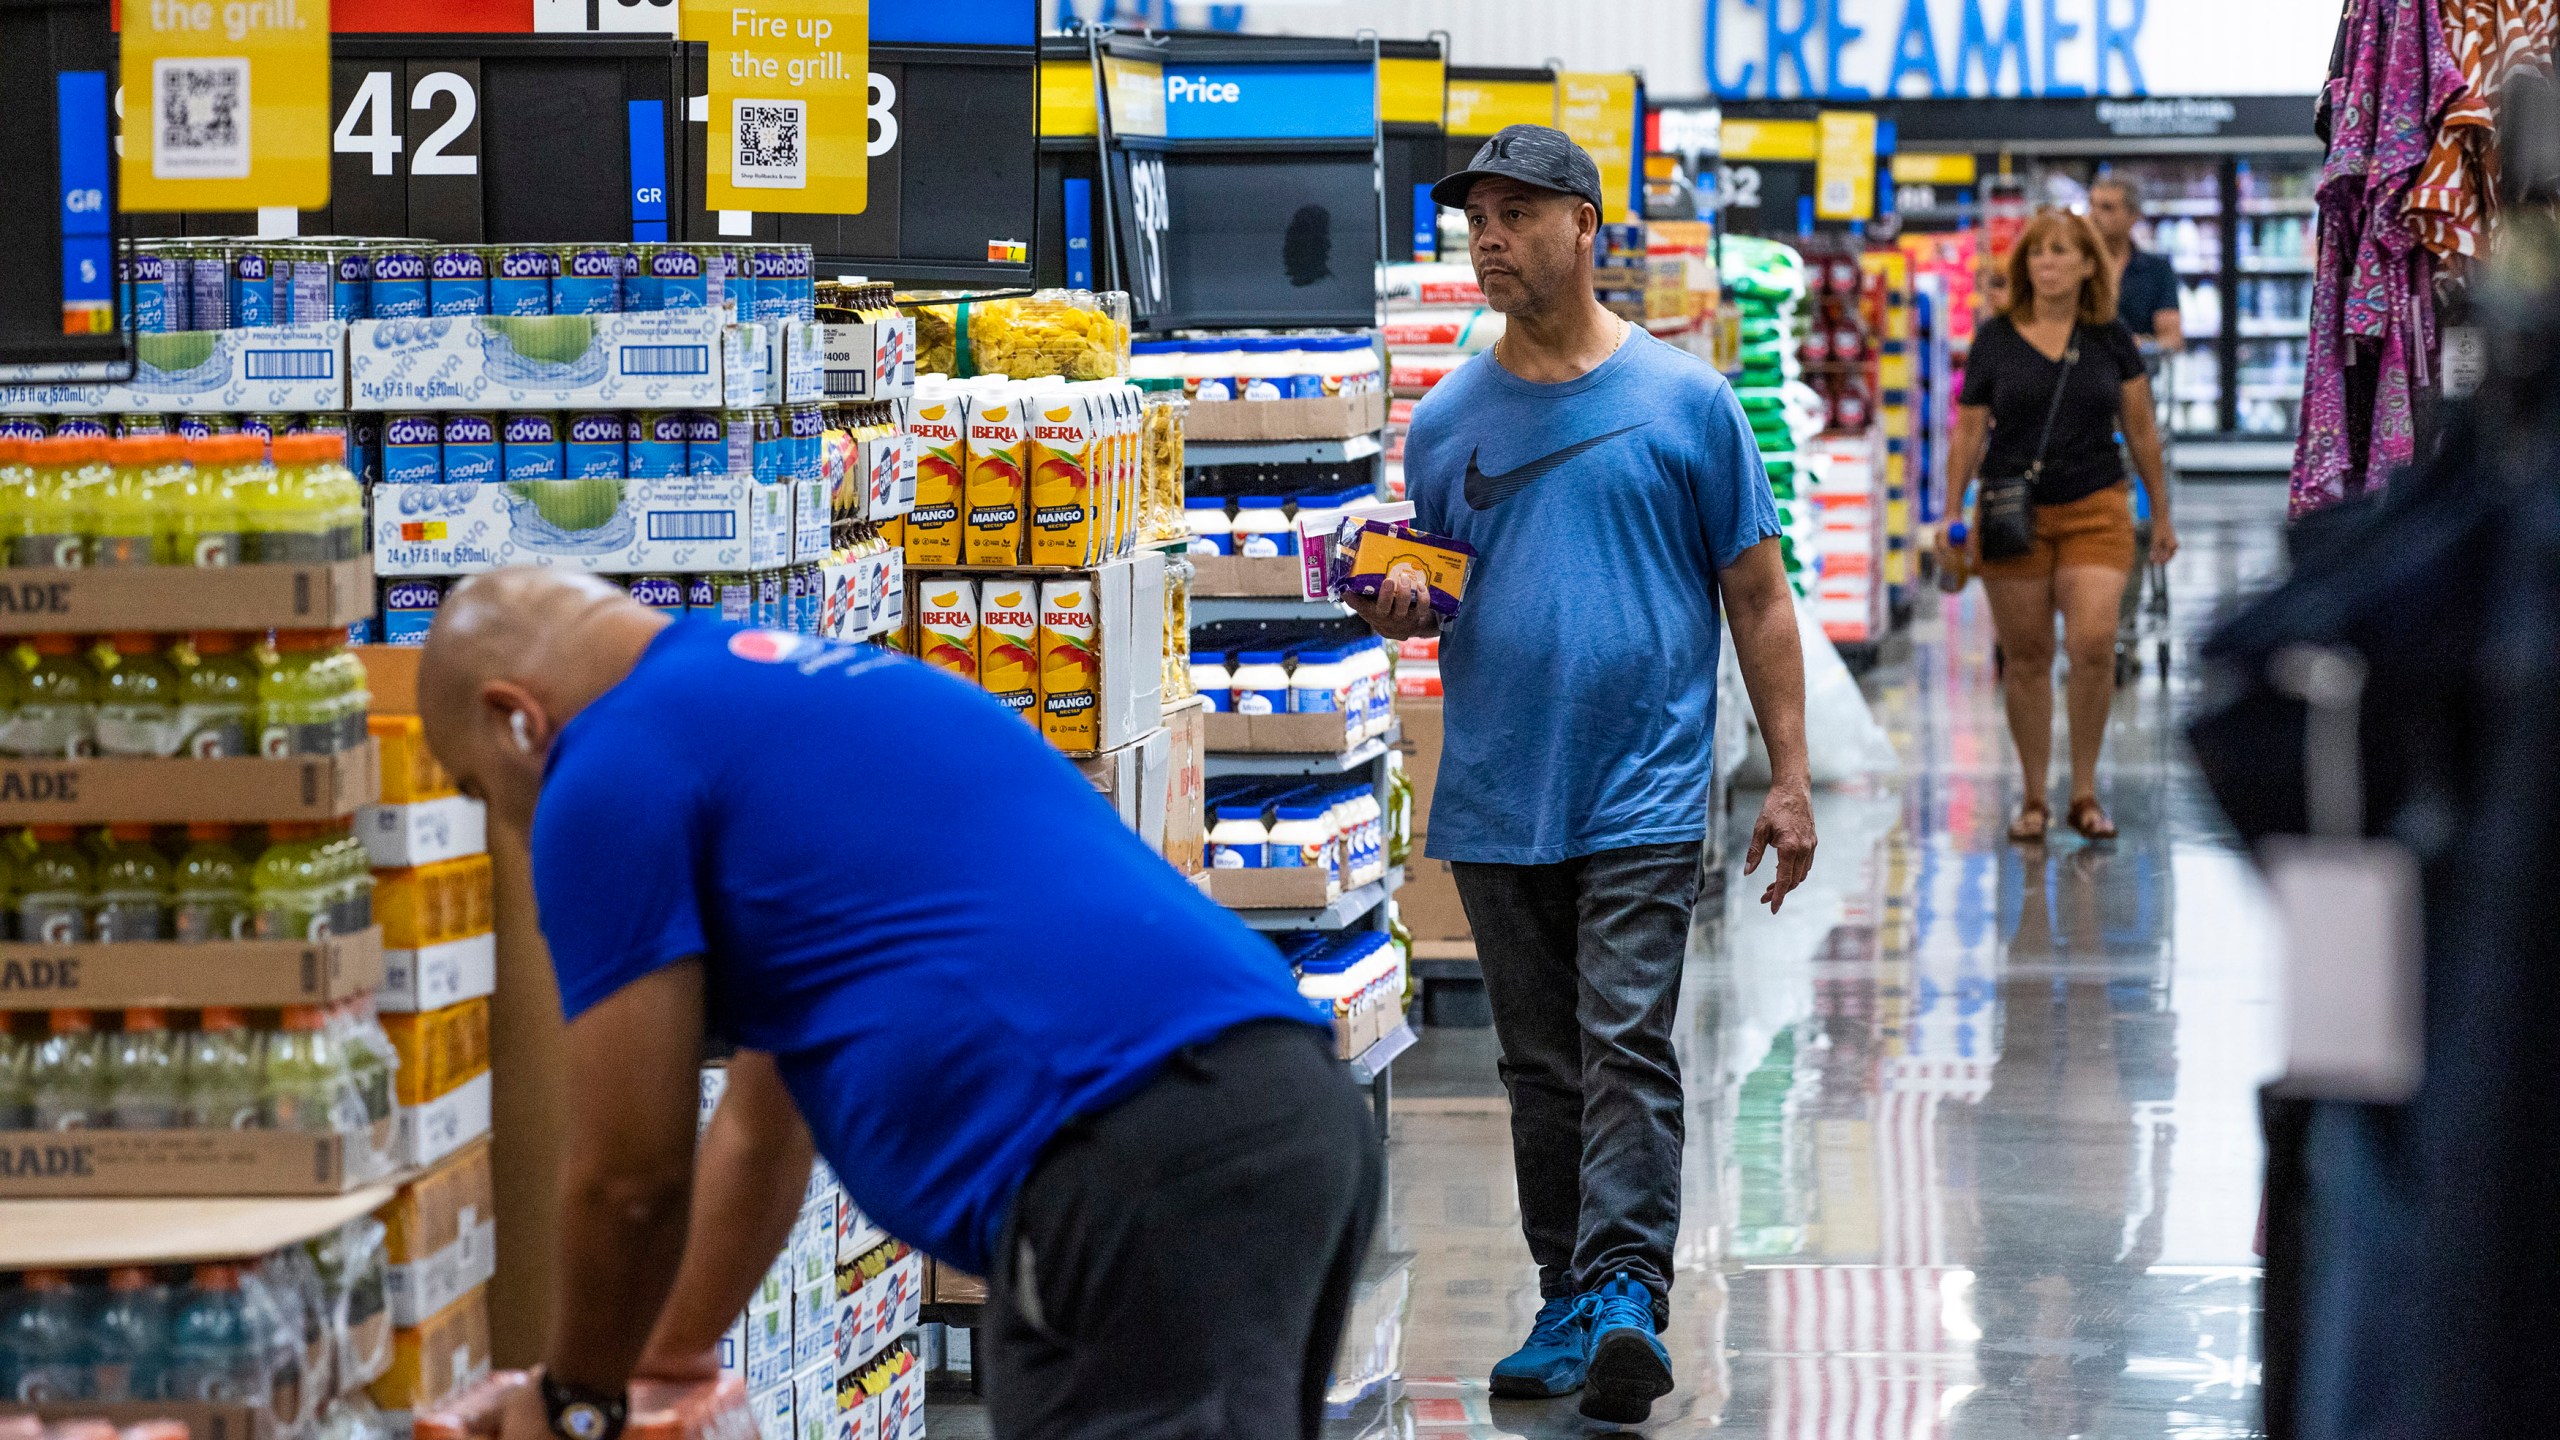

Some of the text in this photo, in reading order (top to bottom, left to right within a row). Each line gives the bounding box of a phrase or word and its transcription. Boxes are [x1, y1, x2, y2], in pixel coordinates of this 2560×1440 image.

[224, 0, 307, 42] grill.
[732, 9, 832, 47] Fire up
[1703, 0, 2149, 99] CREAMER
[730, 50, 850, 86] the grill.
[1168, 75, 1240, 103] Price
[66, 188, 103, 214] GR
[636, 187, 662, 203] GR
[1069, 237, 1088, 249] GR
[375, 259, 425, 279] GOYA
[433, 259, 483, 278] GOYA
[7, 386, 26, 403] 17.6
[37, 391, 48, 402] oz
[361, 383, 373, 397] 24
[384, 382, 403, 398] 17.6
[406, 382, 413, 397] fl
[415, 386, 425, 397] oz
[427, 381, 463, 398] (520mL)
[388, 424, 439, 443] GOYA
[573, 423, 623, 440] GOYA
[910, 425, 958, 443] IBERIA
[972, 425, 1018, 443] IBERIA
[1035, 425, 1084, 443] IBERIA
[911, 509, 955, 522] MANGO
[972, 510, 1016, 524] MANGO
[1037, 510, 1081, 524] MANGO
[388, 549, 400, 563] 24
[410, 549, 430, 563] 17.6
[441, 552, 451, 562] oz
[453, 548, 491, 563] (520mL)
[389, 589, 440, 608] GOYA
[922, 612, 971, 628] IBERIA
[985, 612, 1034, 628] IBERIA
[1044, 612, 1093, 628] IBERIA
[1000, 695, 1034, 708] ANGO
[1048, 696, 1092, 710] MANGO
